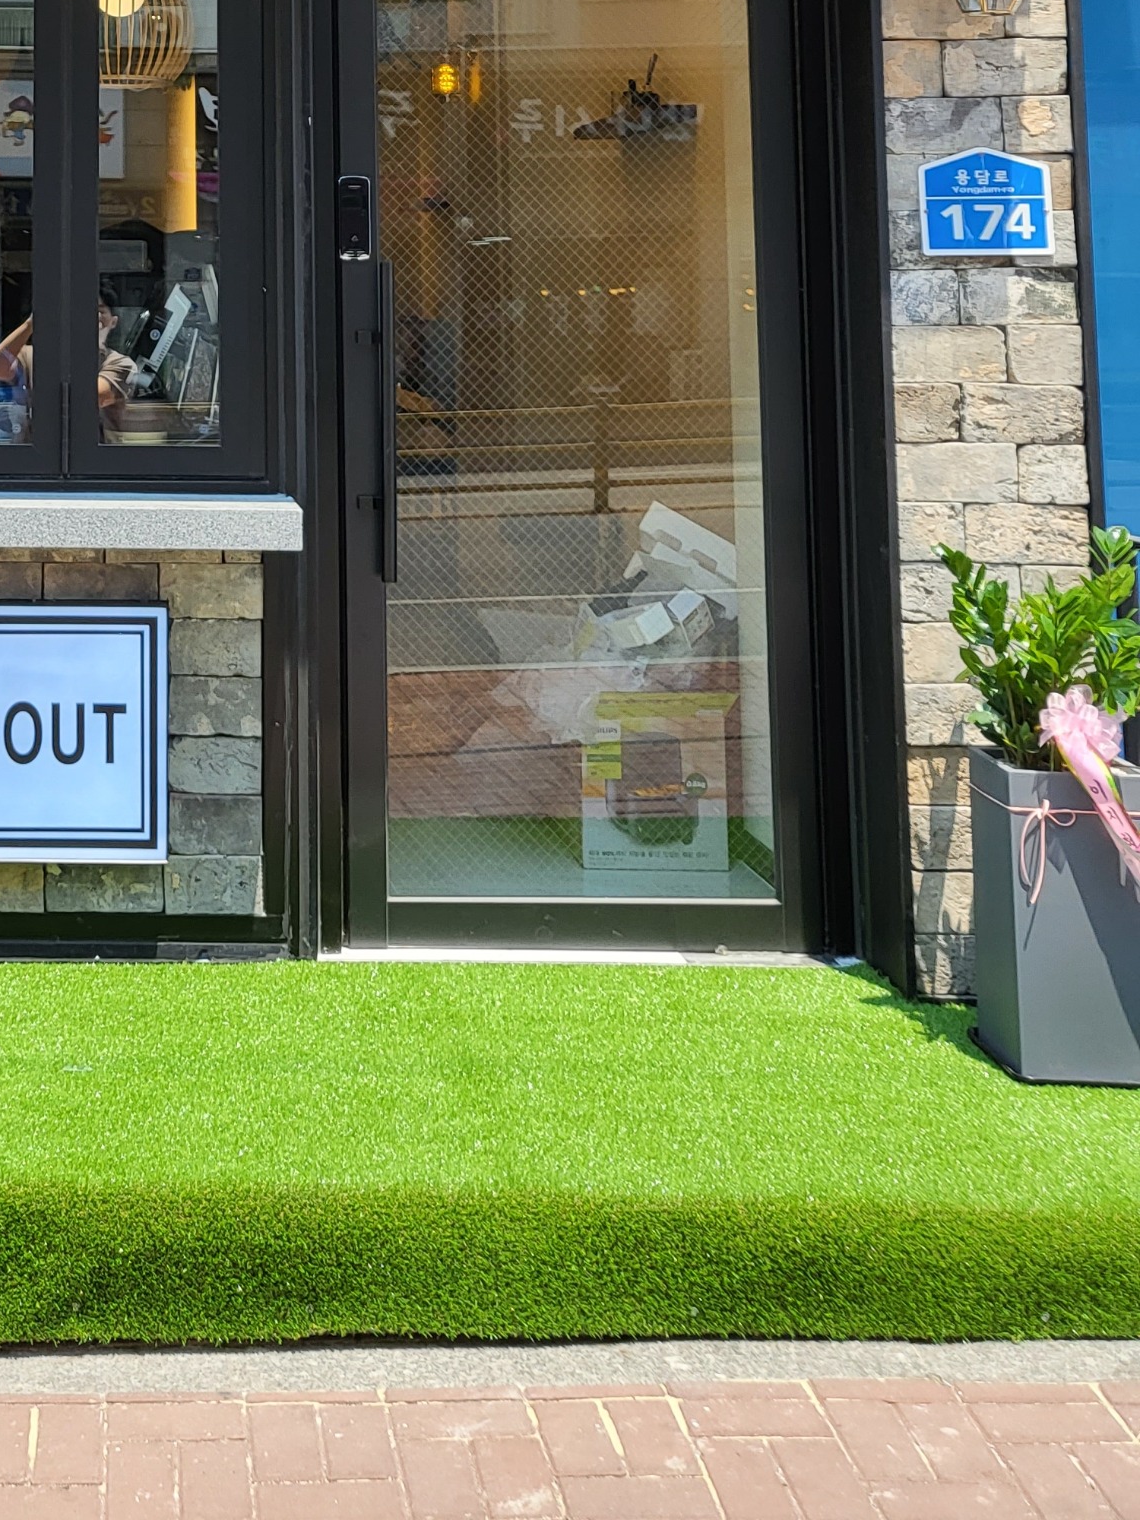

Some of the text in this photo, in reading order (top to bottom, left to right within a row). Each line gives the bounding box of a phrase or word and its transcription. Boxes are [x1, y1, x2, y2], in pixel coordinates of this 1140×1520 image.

[954, 169, 1010, 185] 용담로
[940, 203, 1036, 241] 174
[3, 701, 128, 765] OUT
